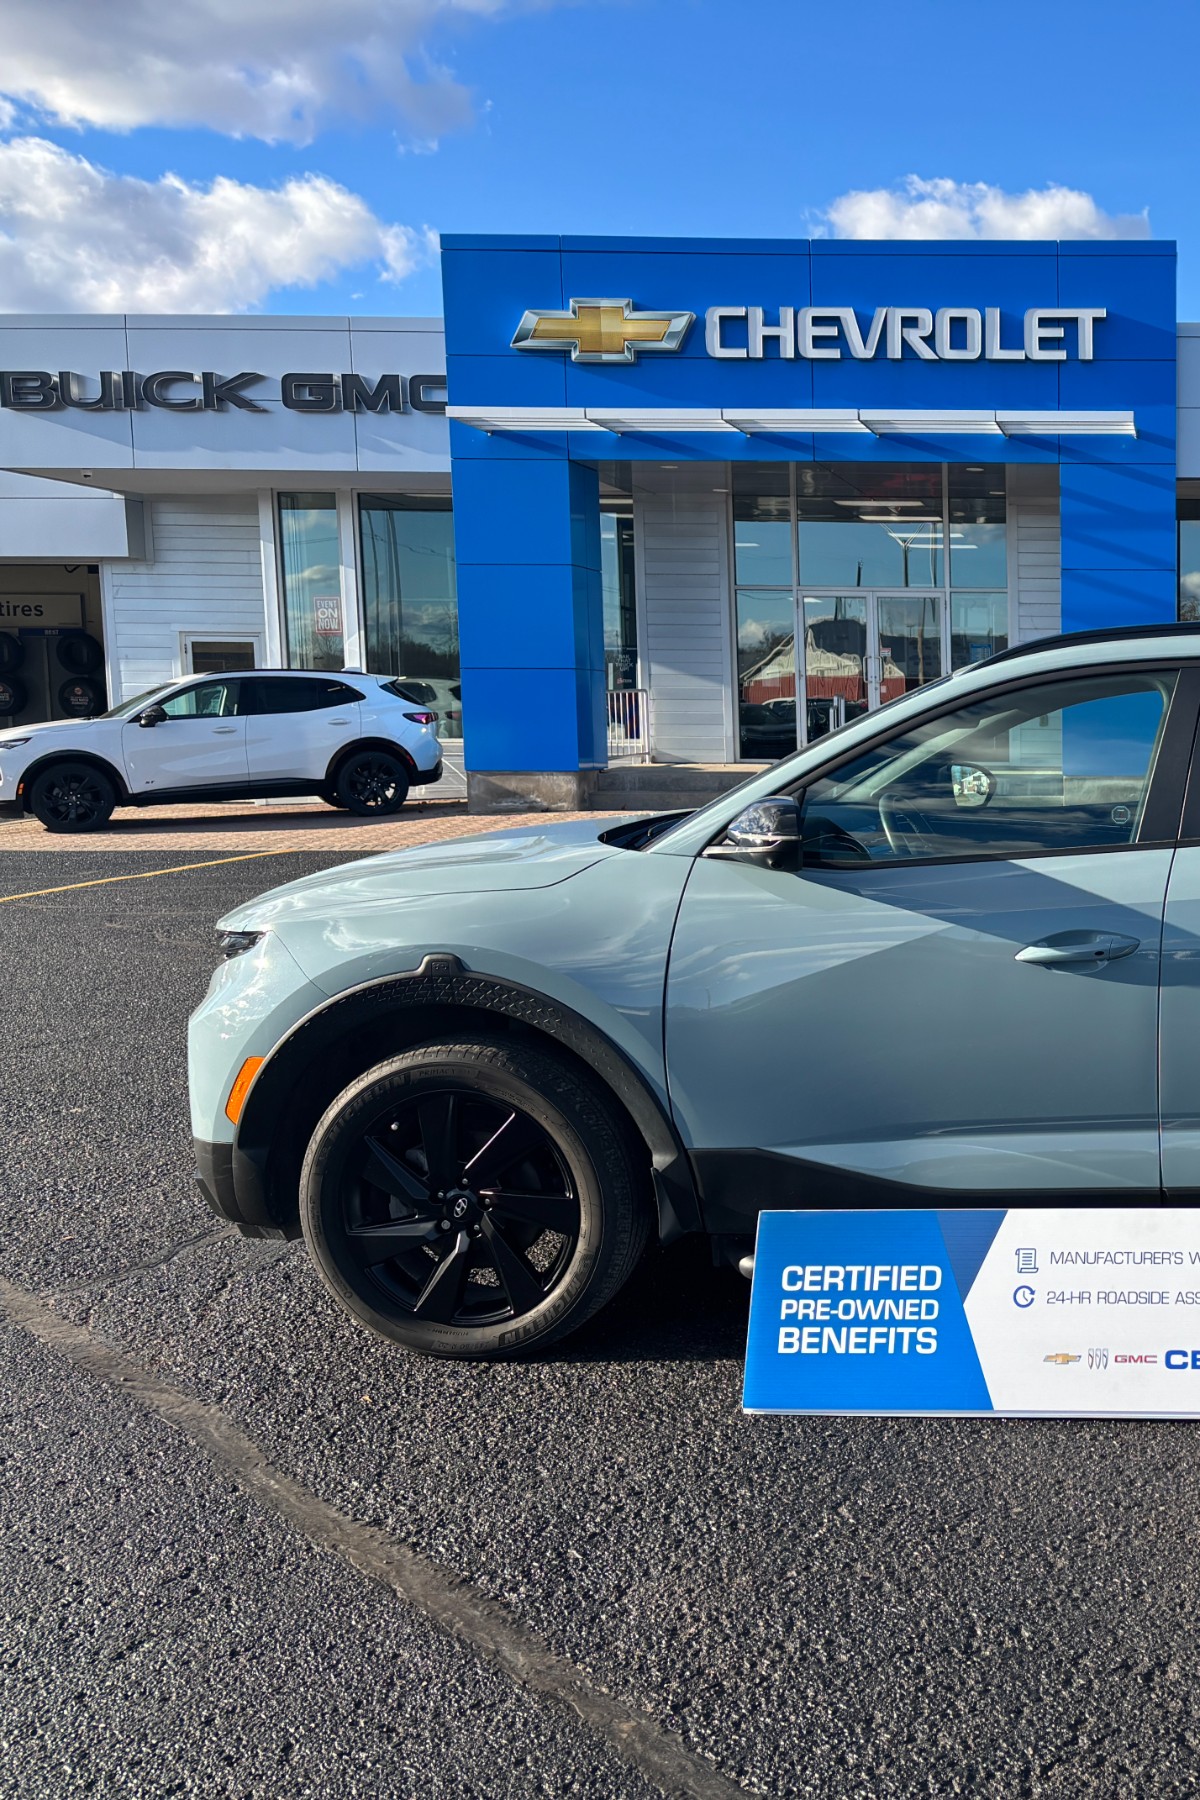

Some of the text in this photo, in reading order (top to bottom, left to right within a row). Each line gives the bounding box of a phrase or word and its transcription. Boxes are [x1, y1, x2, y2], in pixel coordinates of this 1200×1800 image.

[705, 306, 1107, 361] CHEVROLET
[0, 371, 446, 412] BUICK GMC
[316, 600, 337, 608] EVENT
[318, 608, 338, 618] ON
[319, 618, 338, 630] NOW
[1050, 1251, 1184, 1265] MANUFACTURER'S
[781, 1265, 943, 1292] CERTIFIED
[1046, 1291, 1092, 1305] 24-HR
[1097, 1291, 1170, 1305] ROADSIDE
[501, 1277, 581, 1345] MICHELIN
[780, 1299, 940, 1321] PRE-OWNED
[778, 1326, 938, 1355] BENEFITS
[1114, 1355, 1158, 1364] GMC
